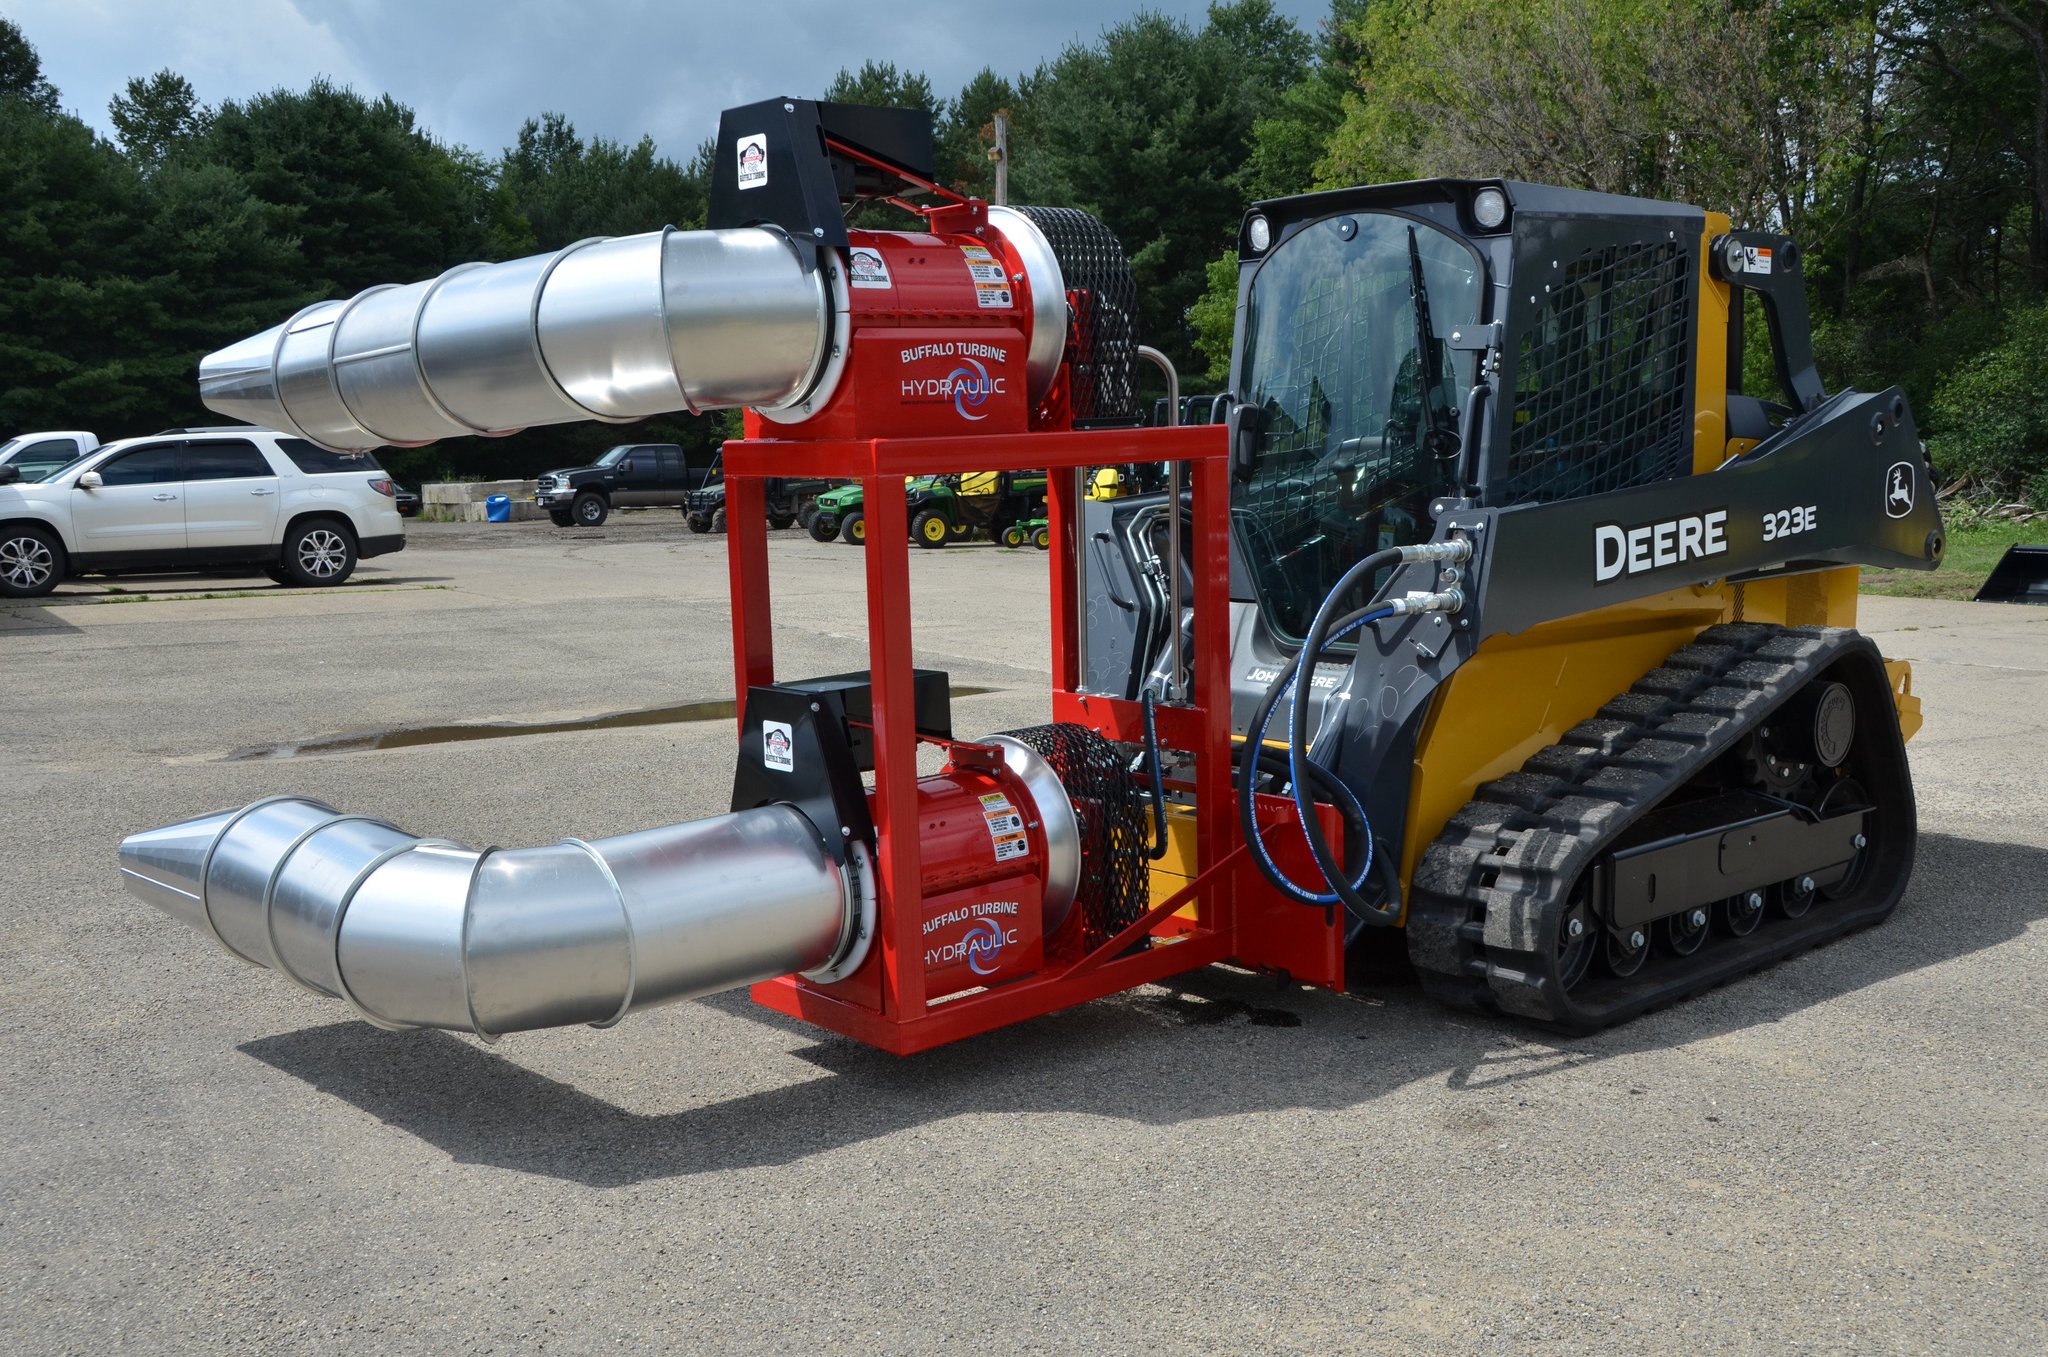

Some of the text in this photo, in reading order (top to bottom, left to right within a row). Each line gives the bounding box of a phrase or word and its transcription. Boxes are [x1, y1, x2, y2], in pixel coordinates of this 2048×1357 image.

[901, 342, 1007, 364] BUFFALO TURBINE
[901, 378, 1006, 396] HYDRAULIC
[1595, 505, 1817, 582] DEERE 323E
[1247, 668, 1338, 689] JOH ERE
[971, 902, 1018, 917] TURBINE
